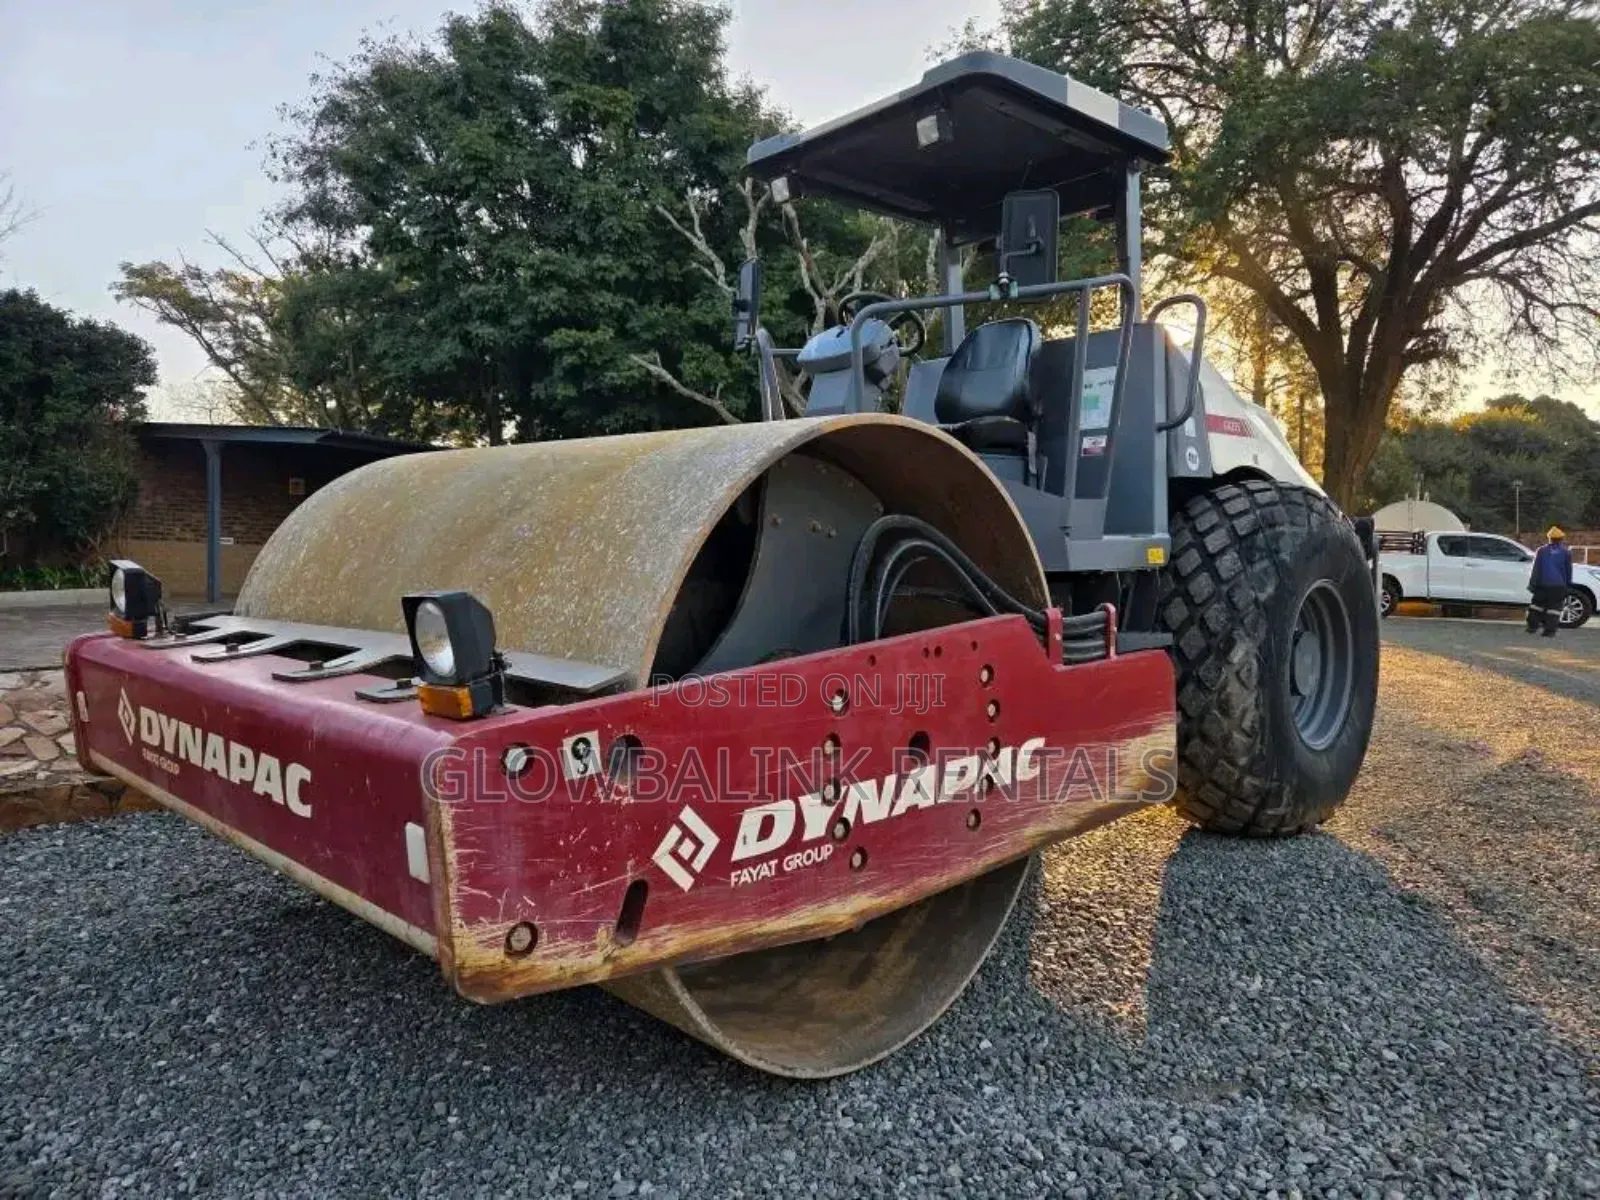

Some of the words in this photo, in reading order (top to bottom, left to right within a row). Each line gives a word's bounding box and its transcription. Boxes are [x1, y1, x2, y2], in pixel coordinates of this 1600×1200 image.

[139, 706, 312, 818] DYNAPAC
[730, 737, 1046, 862] DYNAPAC
[730, 860, 778, 888] FAYAT
[783, 844, 834, 870] GROUP
